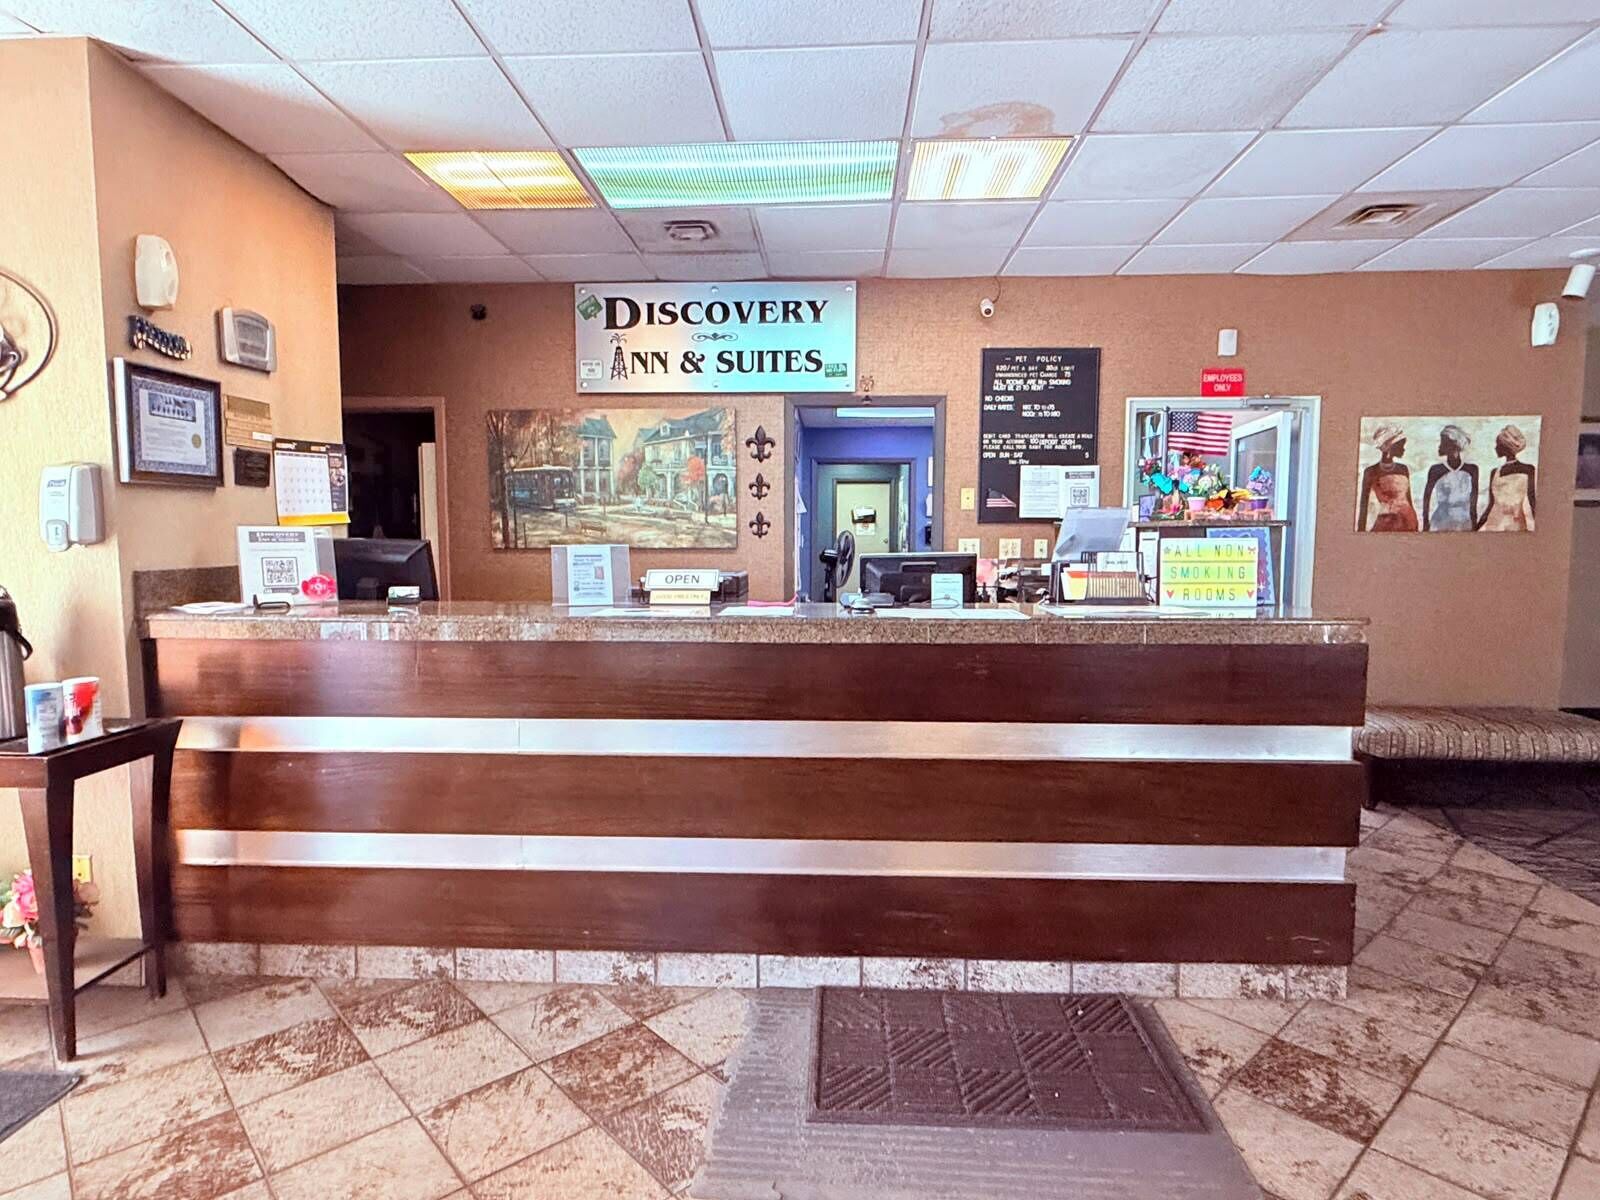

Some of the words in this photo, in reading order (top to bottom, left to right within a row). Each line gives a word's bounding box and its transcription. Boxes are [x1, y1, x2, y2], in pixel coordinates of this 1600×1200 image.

[603, 297, 829, 330] DISCOVERY
[680, 350, 705, 374] &
[716, 349, 823, 374] SUITES
[1203, 373, 1243, 382] EMPLOYEES
[1214, 384, 1232, 392] ONLY
[1174, 544, 1202, 556] ALL
[1214, 544, 1244, 556] NON
[1170, 566, 1246, 580] SMOKING
[664, 574, 700, 584] OPEN
[1182, 590, 1236, 601] ROOMS
